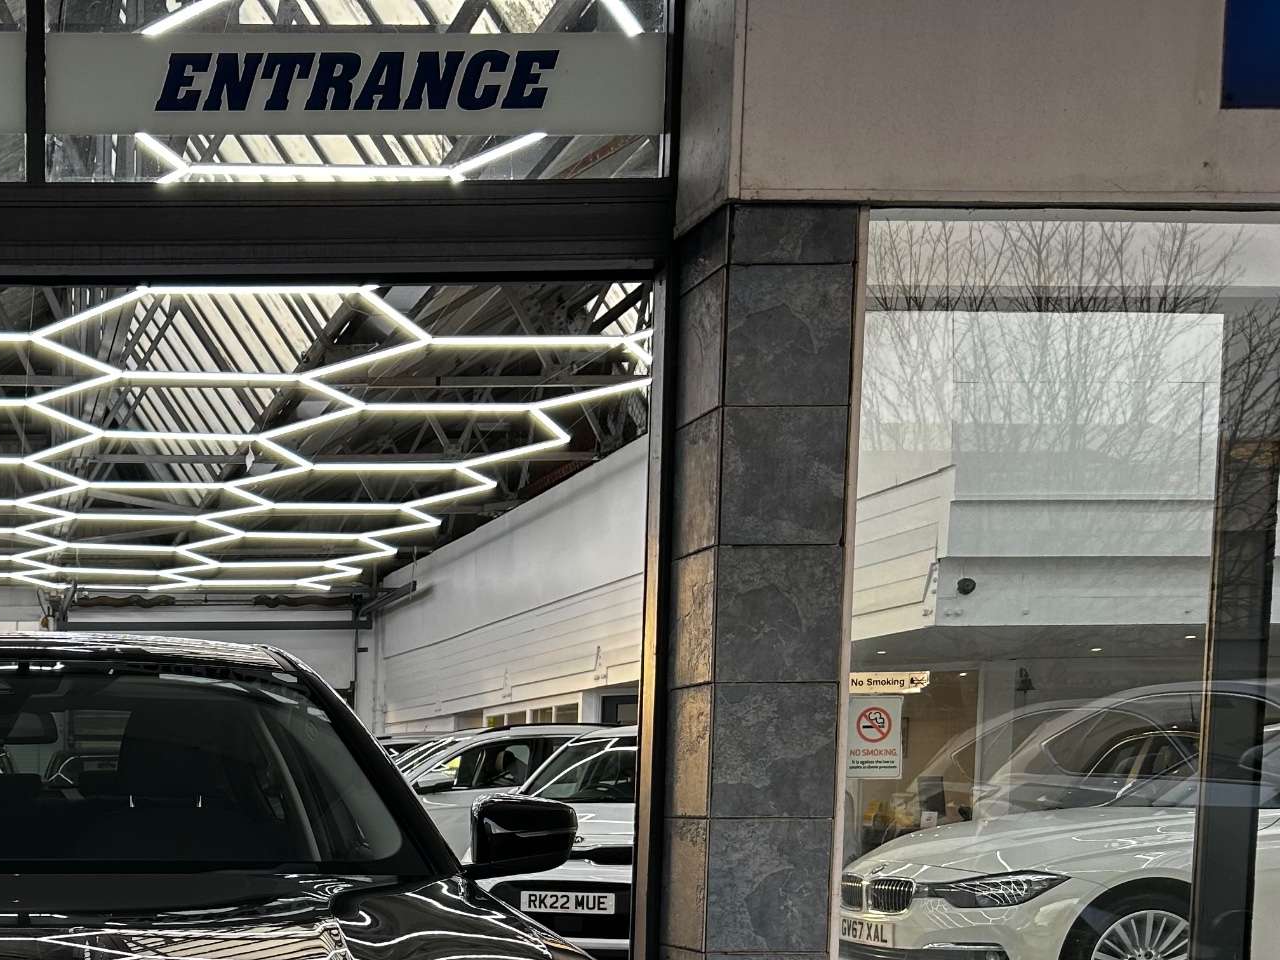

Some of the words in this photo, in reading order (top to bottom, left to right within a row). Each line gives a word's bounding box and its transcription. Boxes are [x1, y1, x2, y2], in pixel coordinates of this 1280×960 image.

[154, 48, 560, 112] ENTRANCE
[851, 678, 864, 687] No
[866, 677, 905, 688] Smoking
[849, 748, 861, 757] NO
[862, 748, 897, 757] SMOKING
[528, 893, 570, 910] RK22
[575, 895, 608, 911] MUE
[841, 918, 864, 939] GV67
[866, 922, 888, 943] XAL
